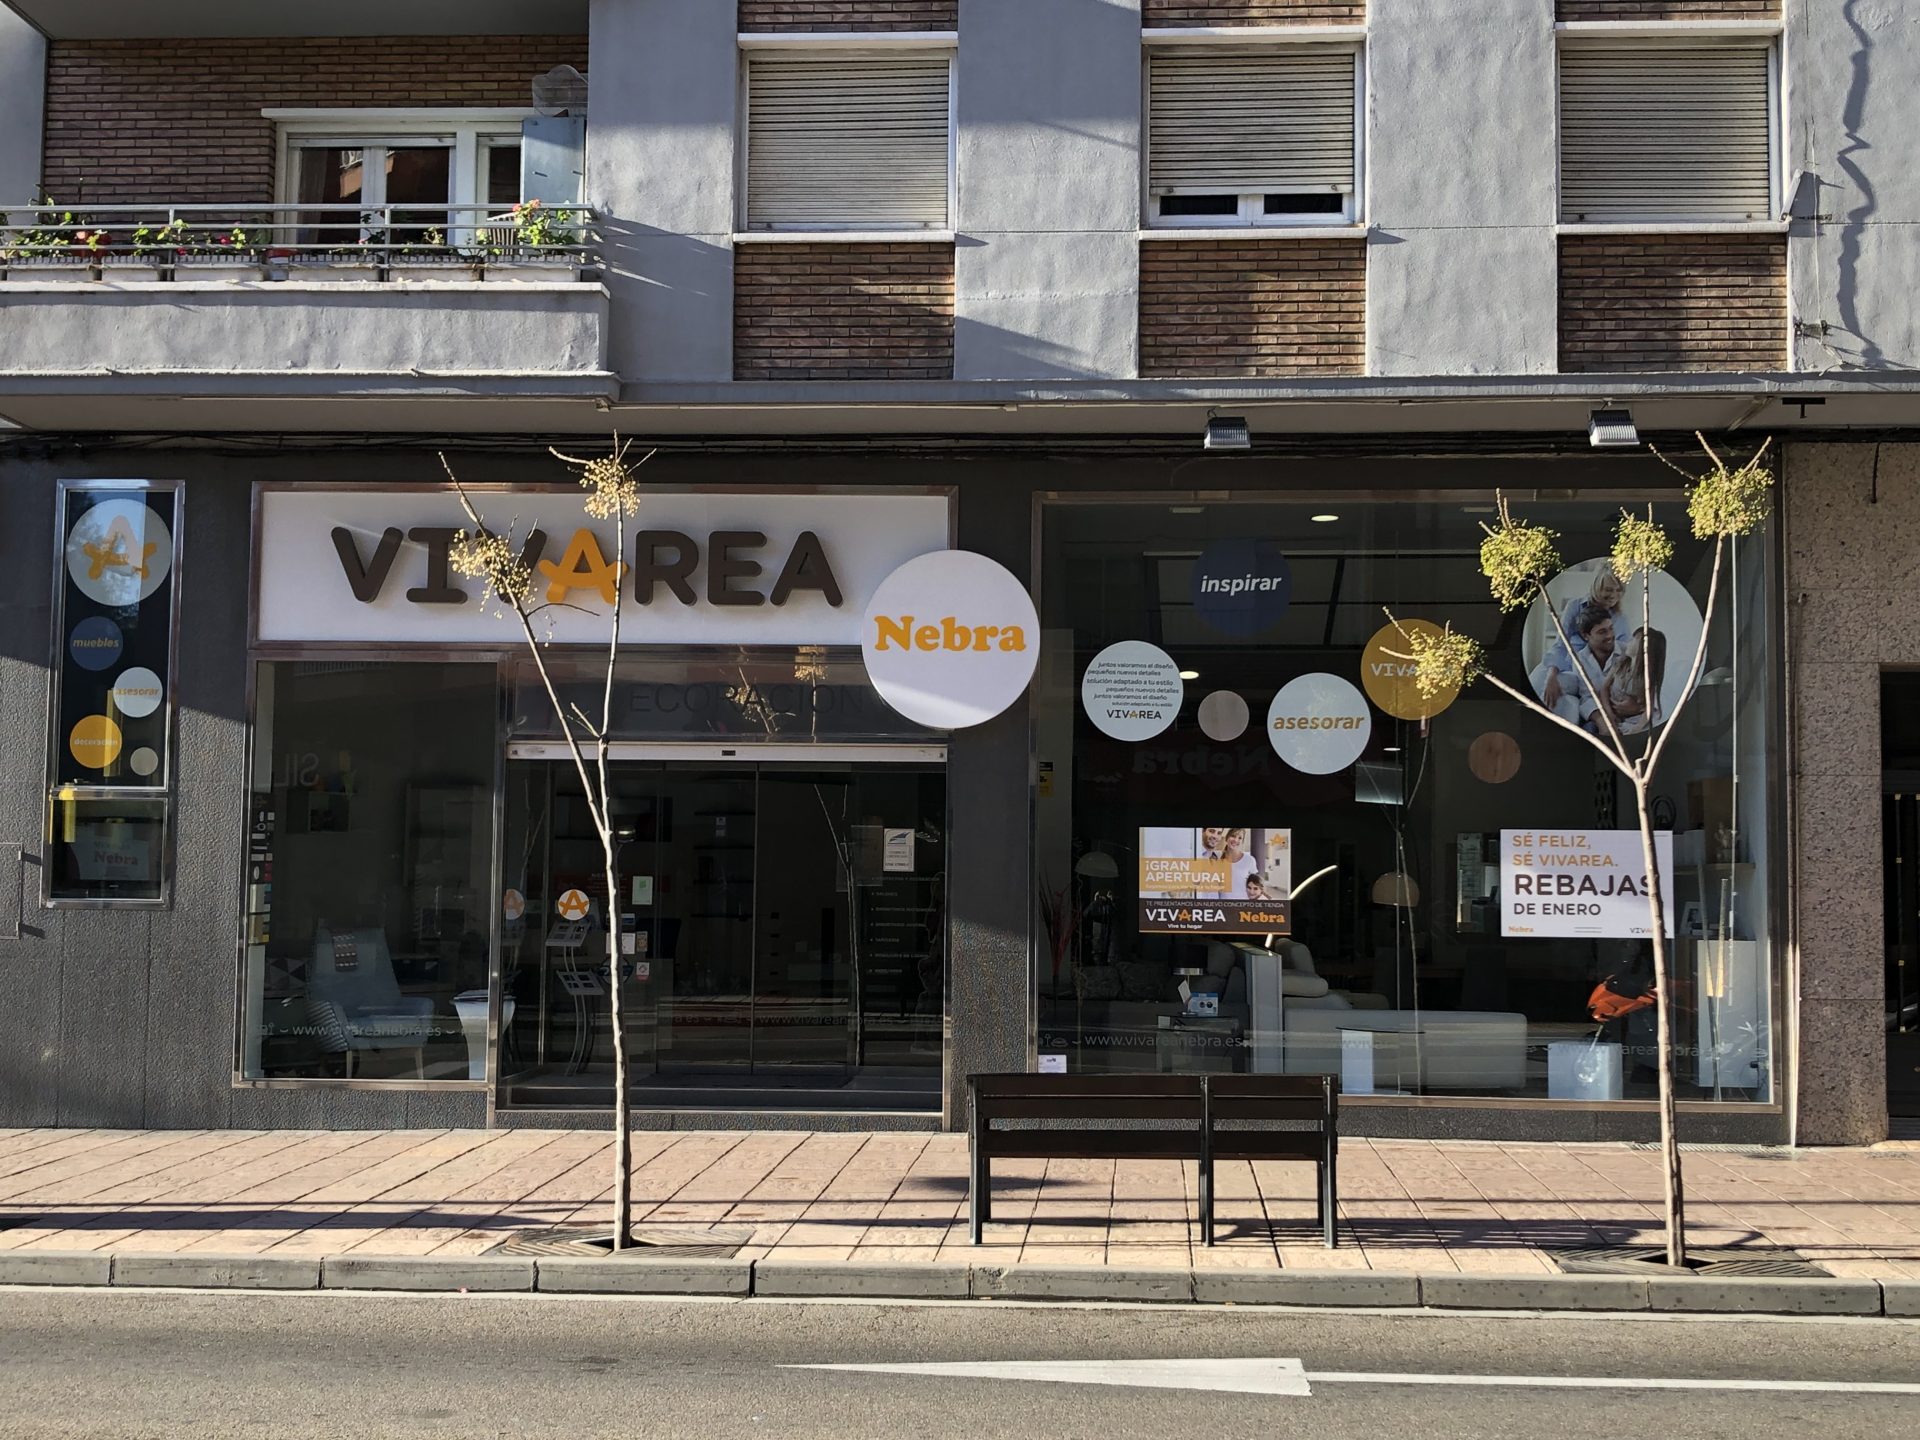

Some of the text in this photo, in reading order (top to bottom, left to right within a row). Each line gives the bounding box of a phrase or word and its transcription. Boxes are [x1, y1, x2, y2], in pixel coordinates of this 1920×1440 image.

[330, 526, 844, 609] VIVAREA
[1200, 574, 1282, 596] inspirar
[874, 615, 1026, 651] Nebra
[73, 637, 119, 648] muebles
[115, 687, 159, 696] asesorar
[1106, 709, 1162, 719] VIVAREA
[1273, 714, 1365, 731] asesorar
[1512, 832, 1592, 849] SÉ FELIZ,
[94, 850, 138, 865] Nebra
[1512, 851, 1619, 867] SÉ VIVAREA.
[1146, 861, 1190, 871] ¡GRAN
[1145, 872, 1225, 883] APERTURA!
[1146, 908, 1286, 923] VIVAREA Nebra
[1514, 903, 1602, 916] DE ENERO
